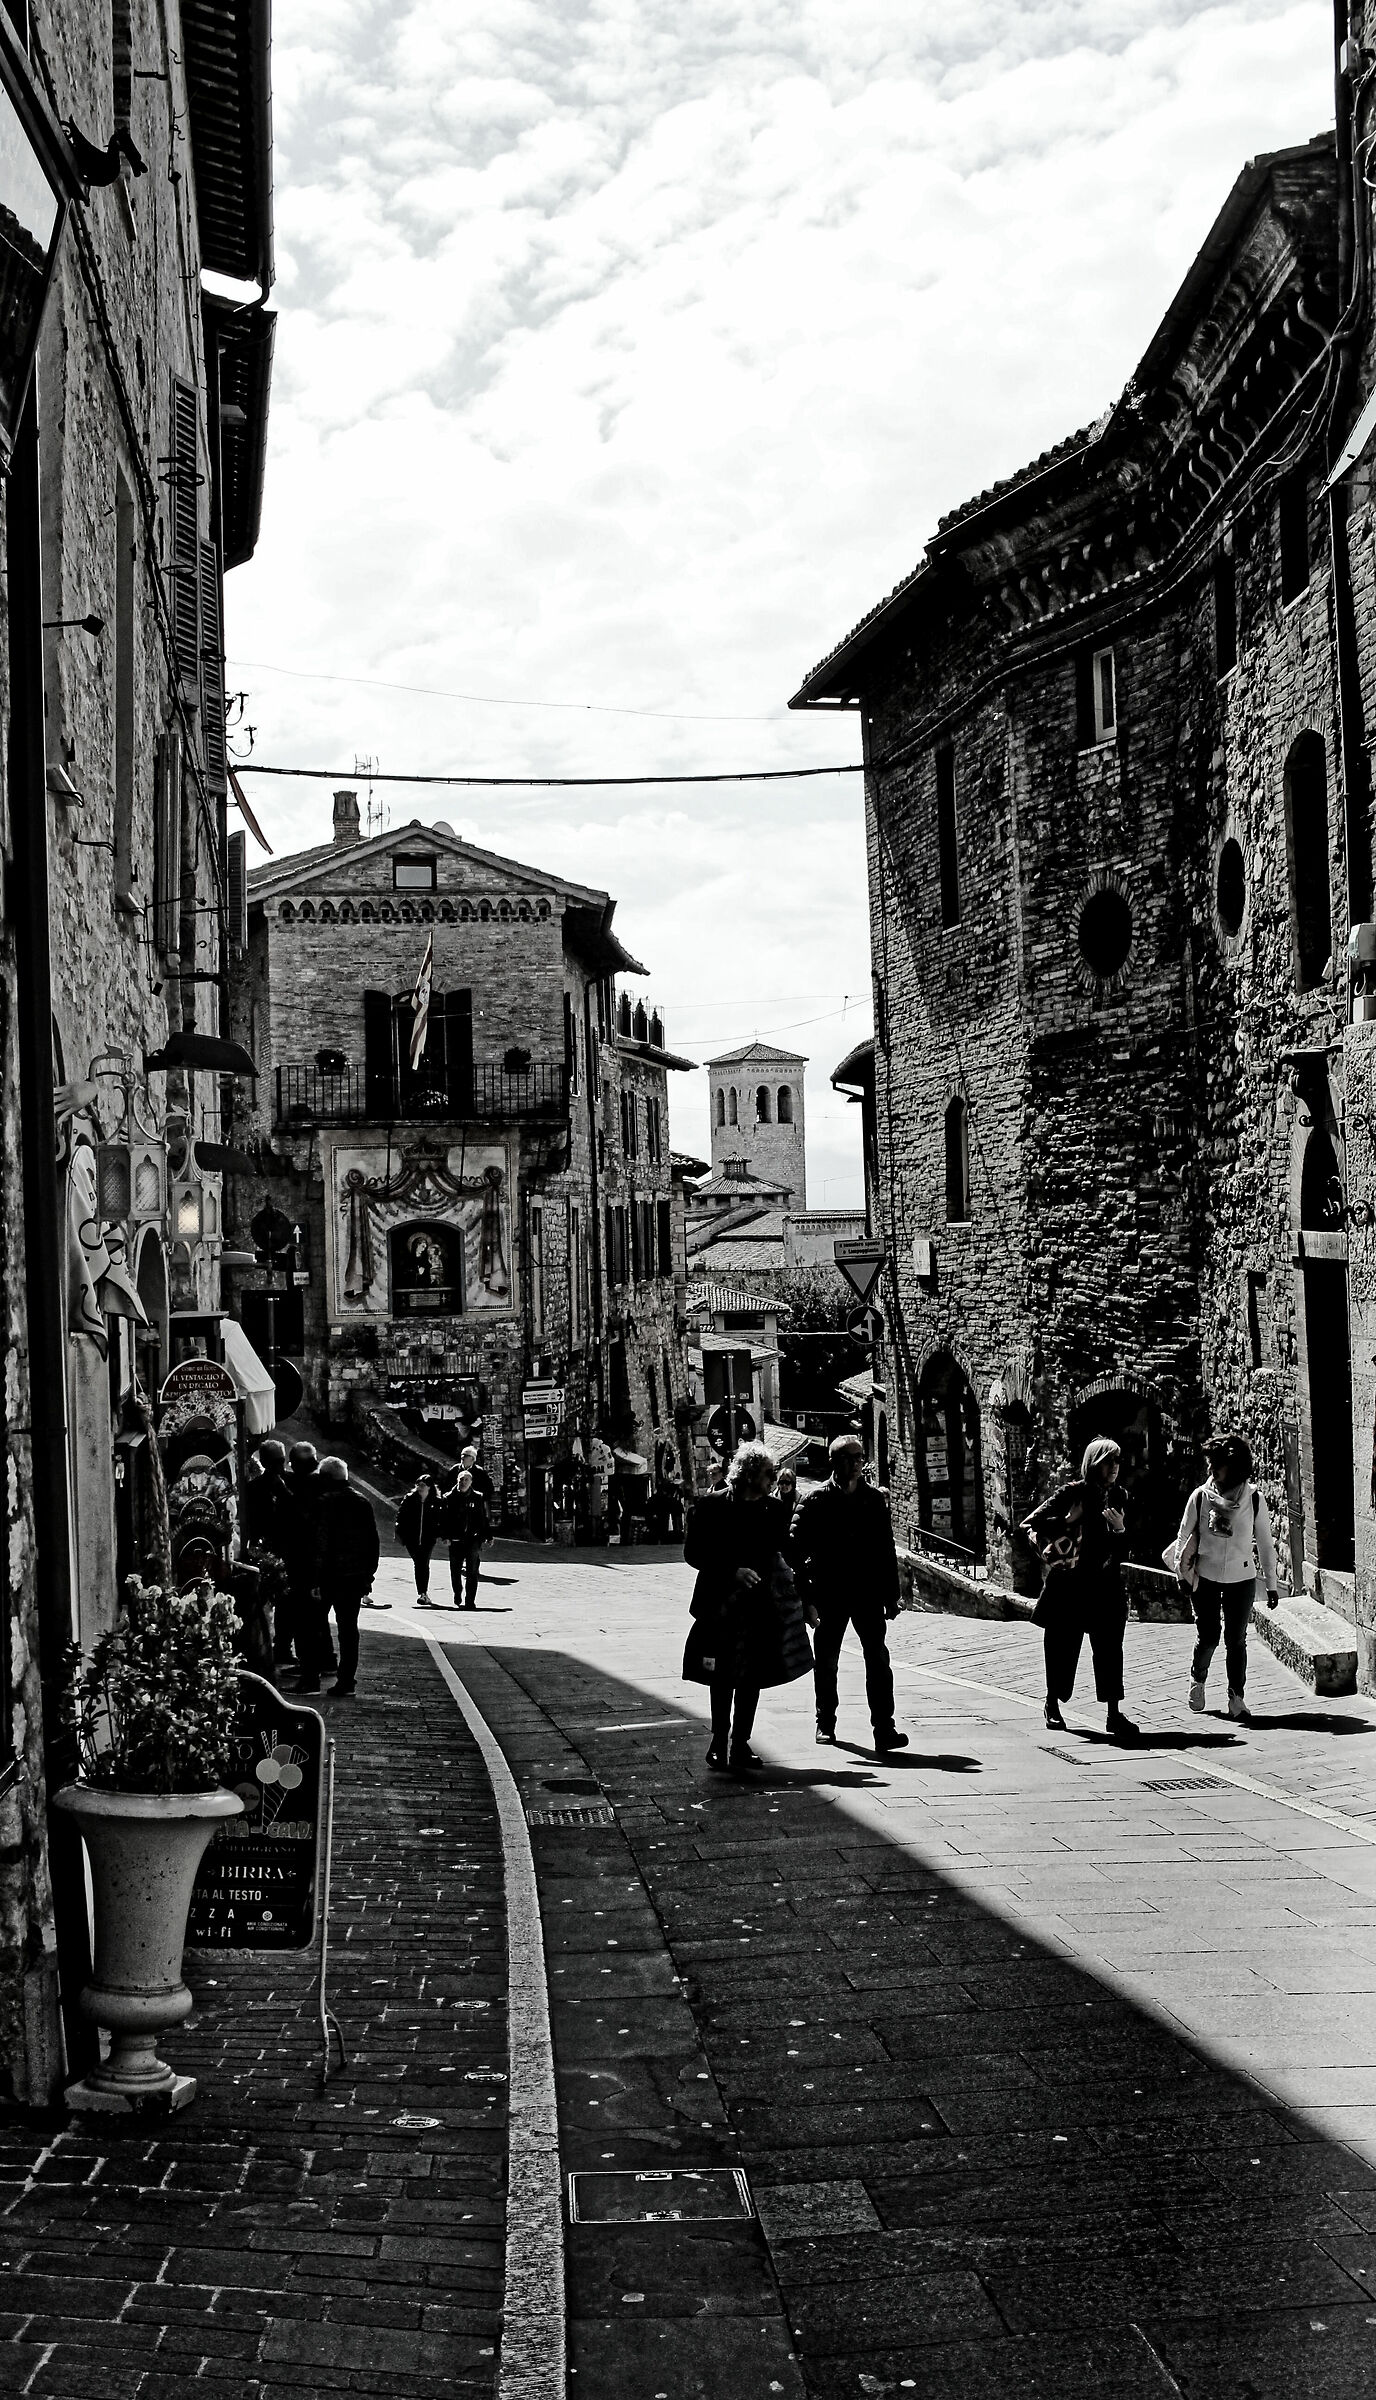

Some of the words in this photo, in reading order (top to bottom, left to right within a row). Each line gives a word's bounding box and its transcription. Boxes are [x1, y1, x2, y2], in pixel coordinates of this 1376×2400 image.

[180, 1373, 220, 1382] VENTAGLIO
[188, 1382, 219, 1390] REGALO
[220, 1865, 284, 1880] BIRRA
[212, 1889, 225, 1900] AL
[228, 1889, 262, 1901] TESTO
[195, 1926, 232, 1938] wi-fi
